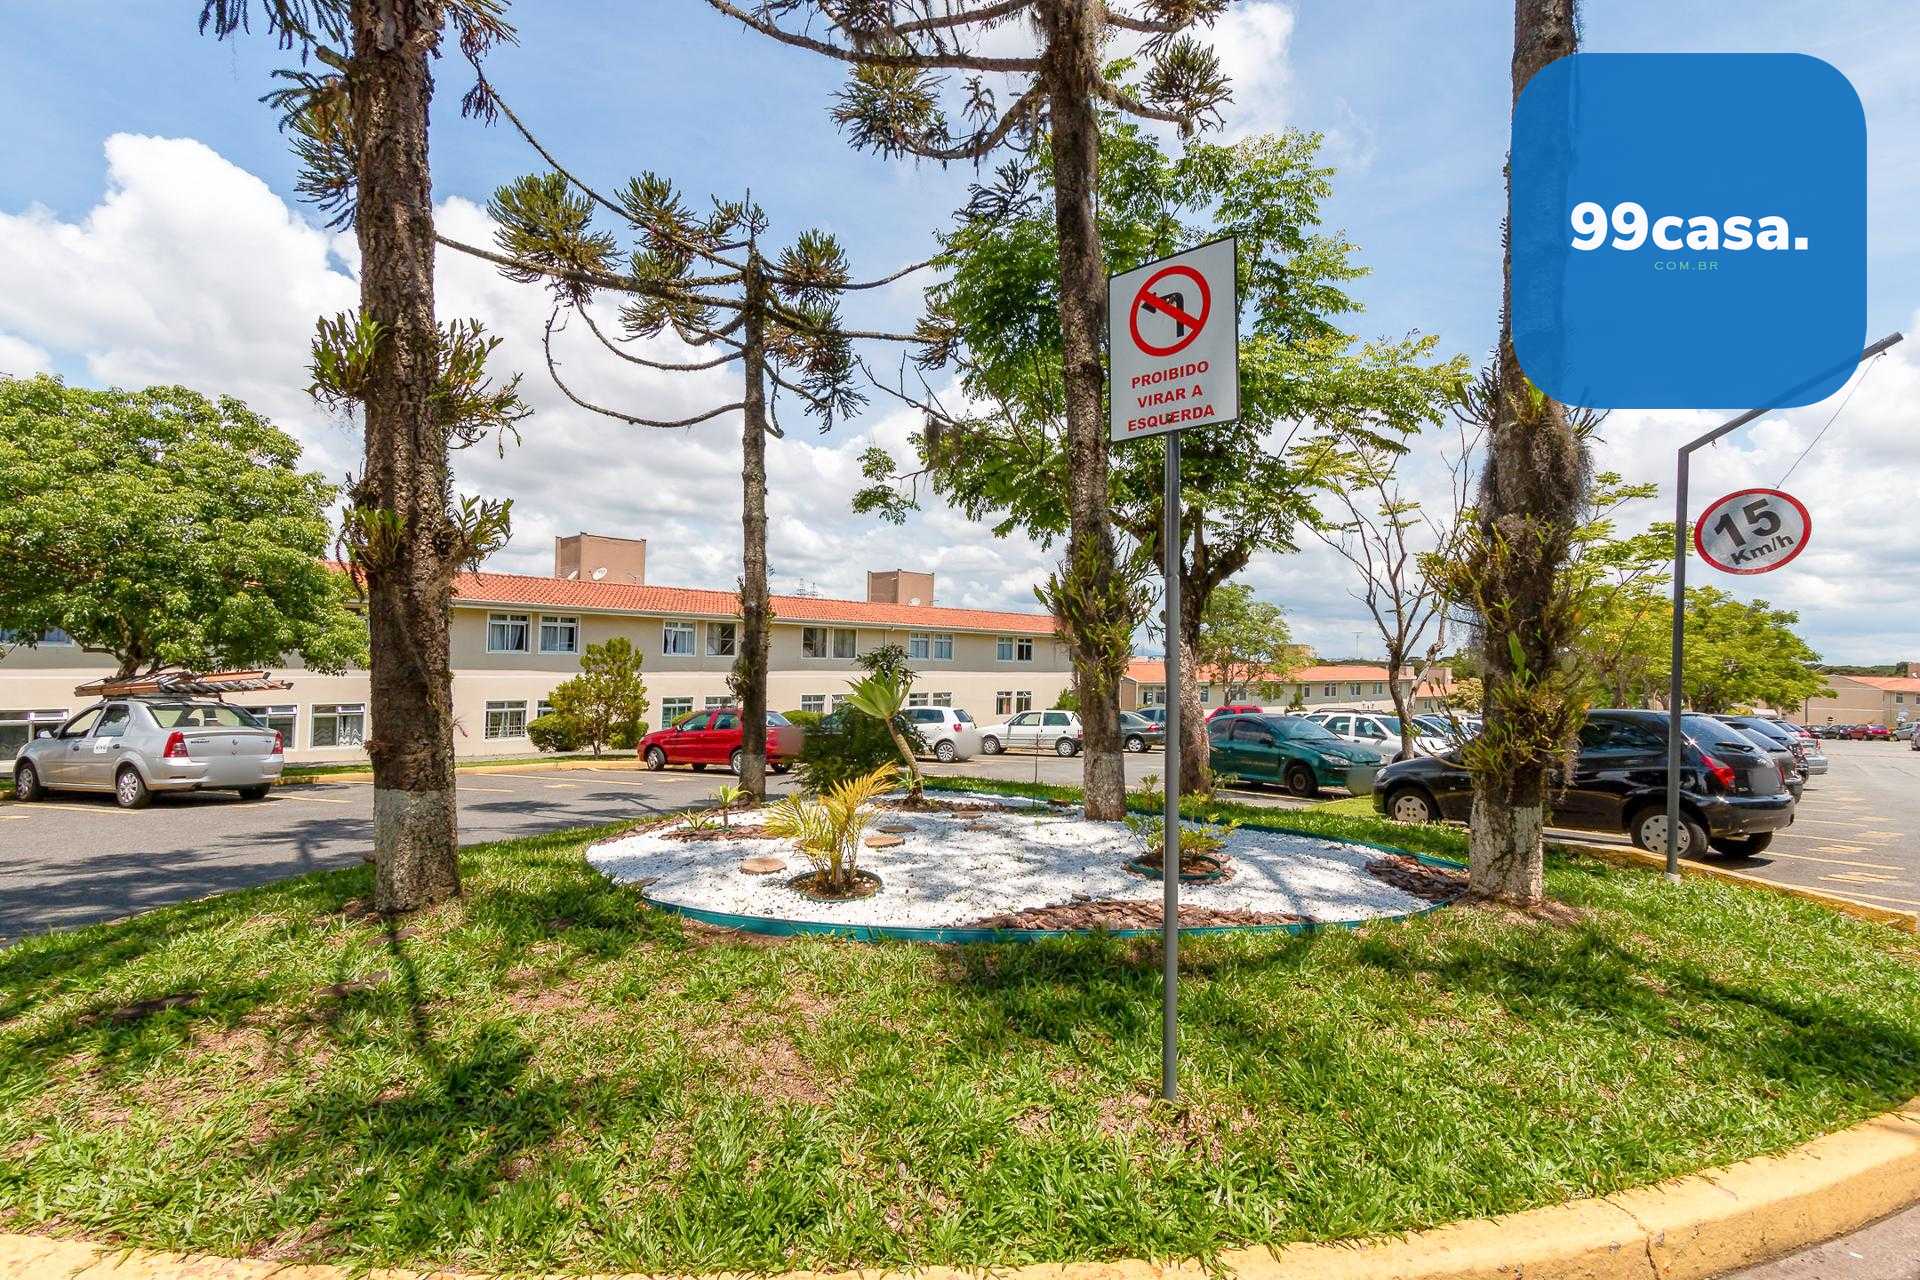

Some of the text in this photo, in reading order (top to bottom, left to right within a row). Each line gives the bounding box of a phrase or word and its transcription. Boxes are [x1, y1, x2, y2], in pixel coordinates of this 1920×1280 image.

[1131, 361, 1209, 388] PROIBIDO
[1137, 384, 1203, 408] VIRAR A
[1127, 404, 1215, 432] ESQUERDA
[1713, 498, 1781, 547] 15
